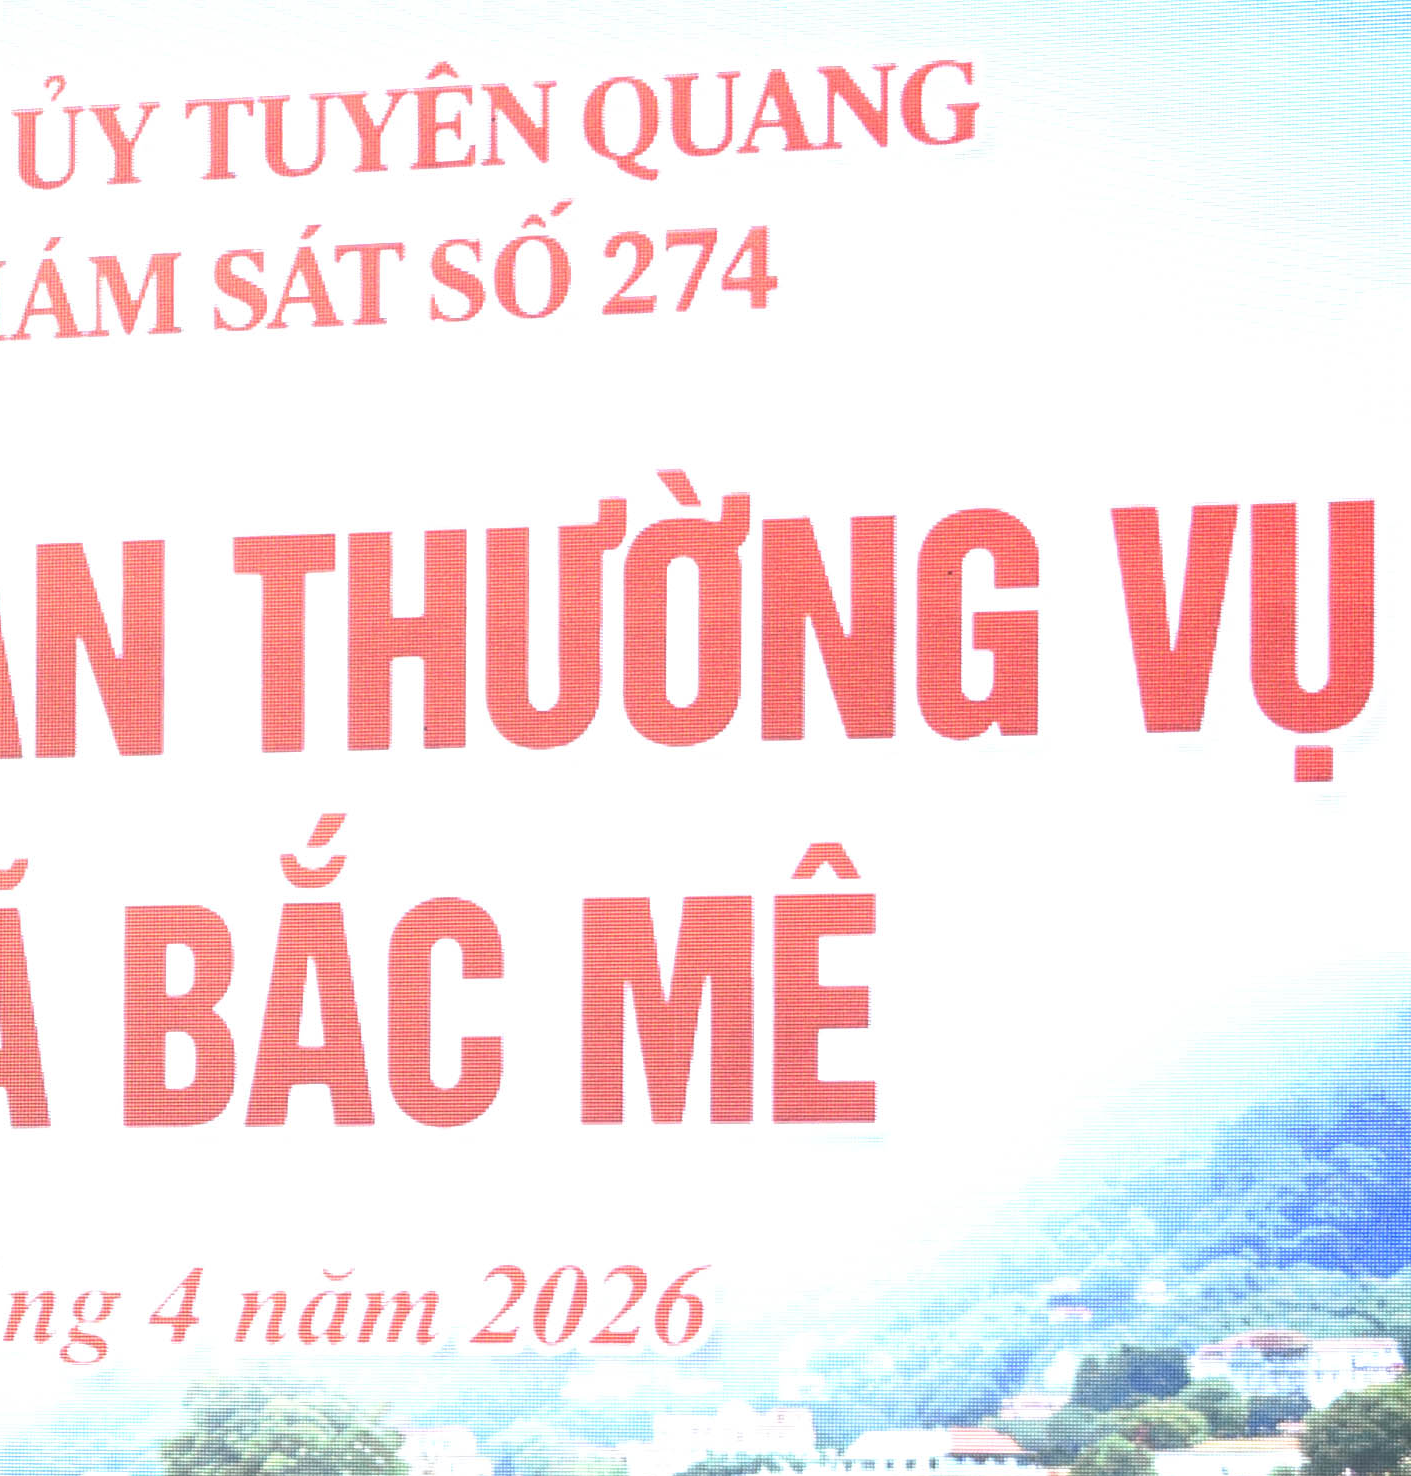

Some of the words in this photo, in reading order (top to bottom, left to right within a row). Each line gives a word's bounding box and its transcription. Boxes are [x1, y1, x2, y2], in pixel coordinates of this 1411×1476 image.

[13, 75, 160, 190] ỦY
[185, 62, 556, 180] TUYÊN
[584, 60, 979, 180] QUANG
[214, 225, 405, 331] SÁT
[431, 201, 571, 322] SỐ
[603, 226, 778, 315] 274
[233, 470, 1039, 752] THƯỜNG
[1111, 500, 1375, 782] VỤ
[123, 813, 504, 1128] BẮC
[582, 843, 875, 1124] MÊ
[150, 1268, 203, 1342] 4
[235, 1272, 439, 1344] năm
[470, 1265, 705, 1344] 2026
